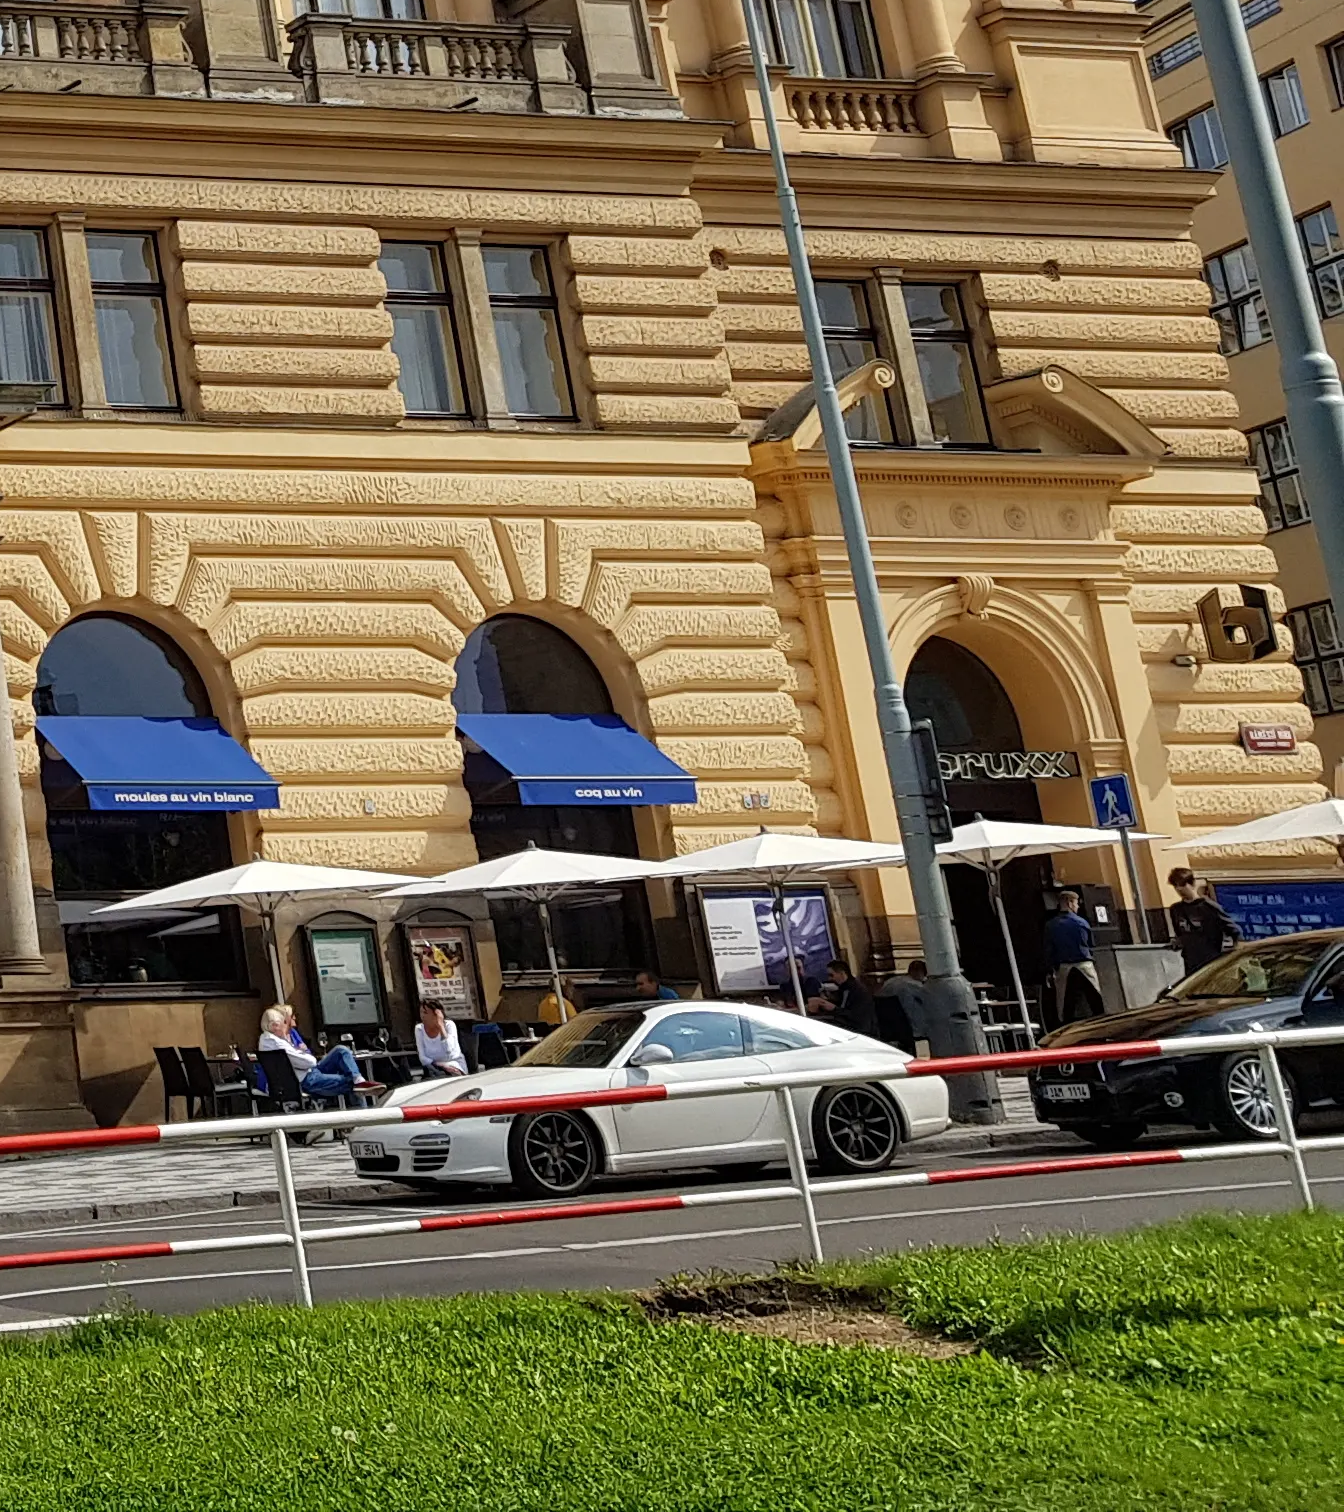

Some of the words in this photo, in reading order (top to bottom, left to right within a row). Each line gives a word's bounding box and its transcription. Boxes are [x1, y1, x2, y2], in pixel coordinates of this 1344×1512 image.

[115, 791, 168, 803] moules
[170, 792, 188, 803] au
[190, 791, 212, 802] vin
[214, 791, 254, 803] blanc
[575, 788, 603, 799] coq
[604, 789, 620, 798] au
[622, 786, 643, 797] vin
